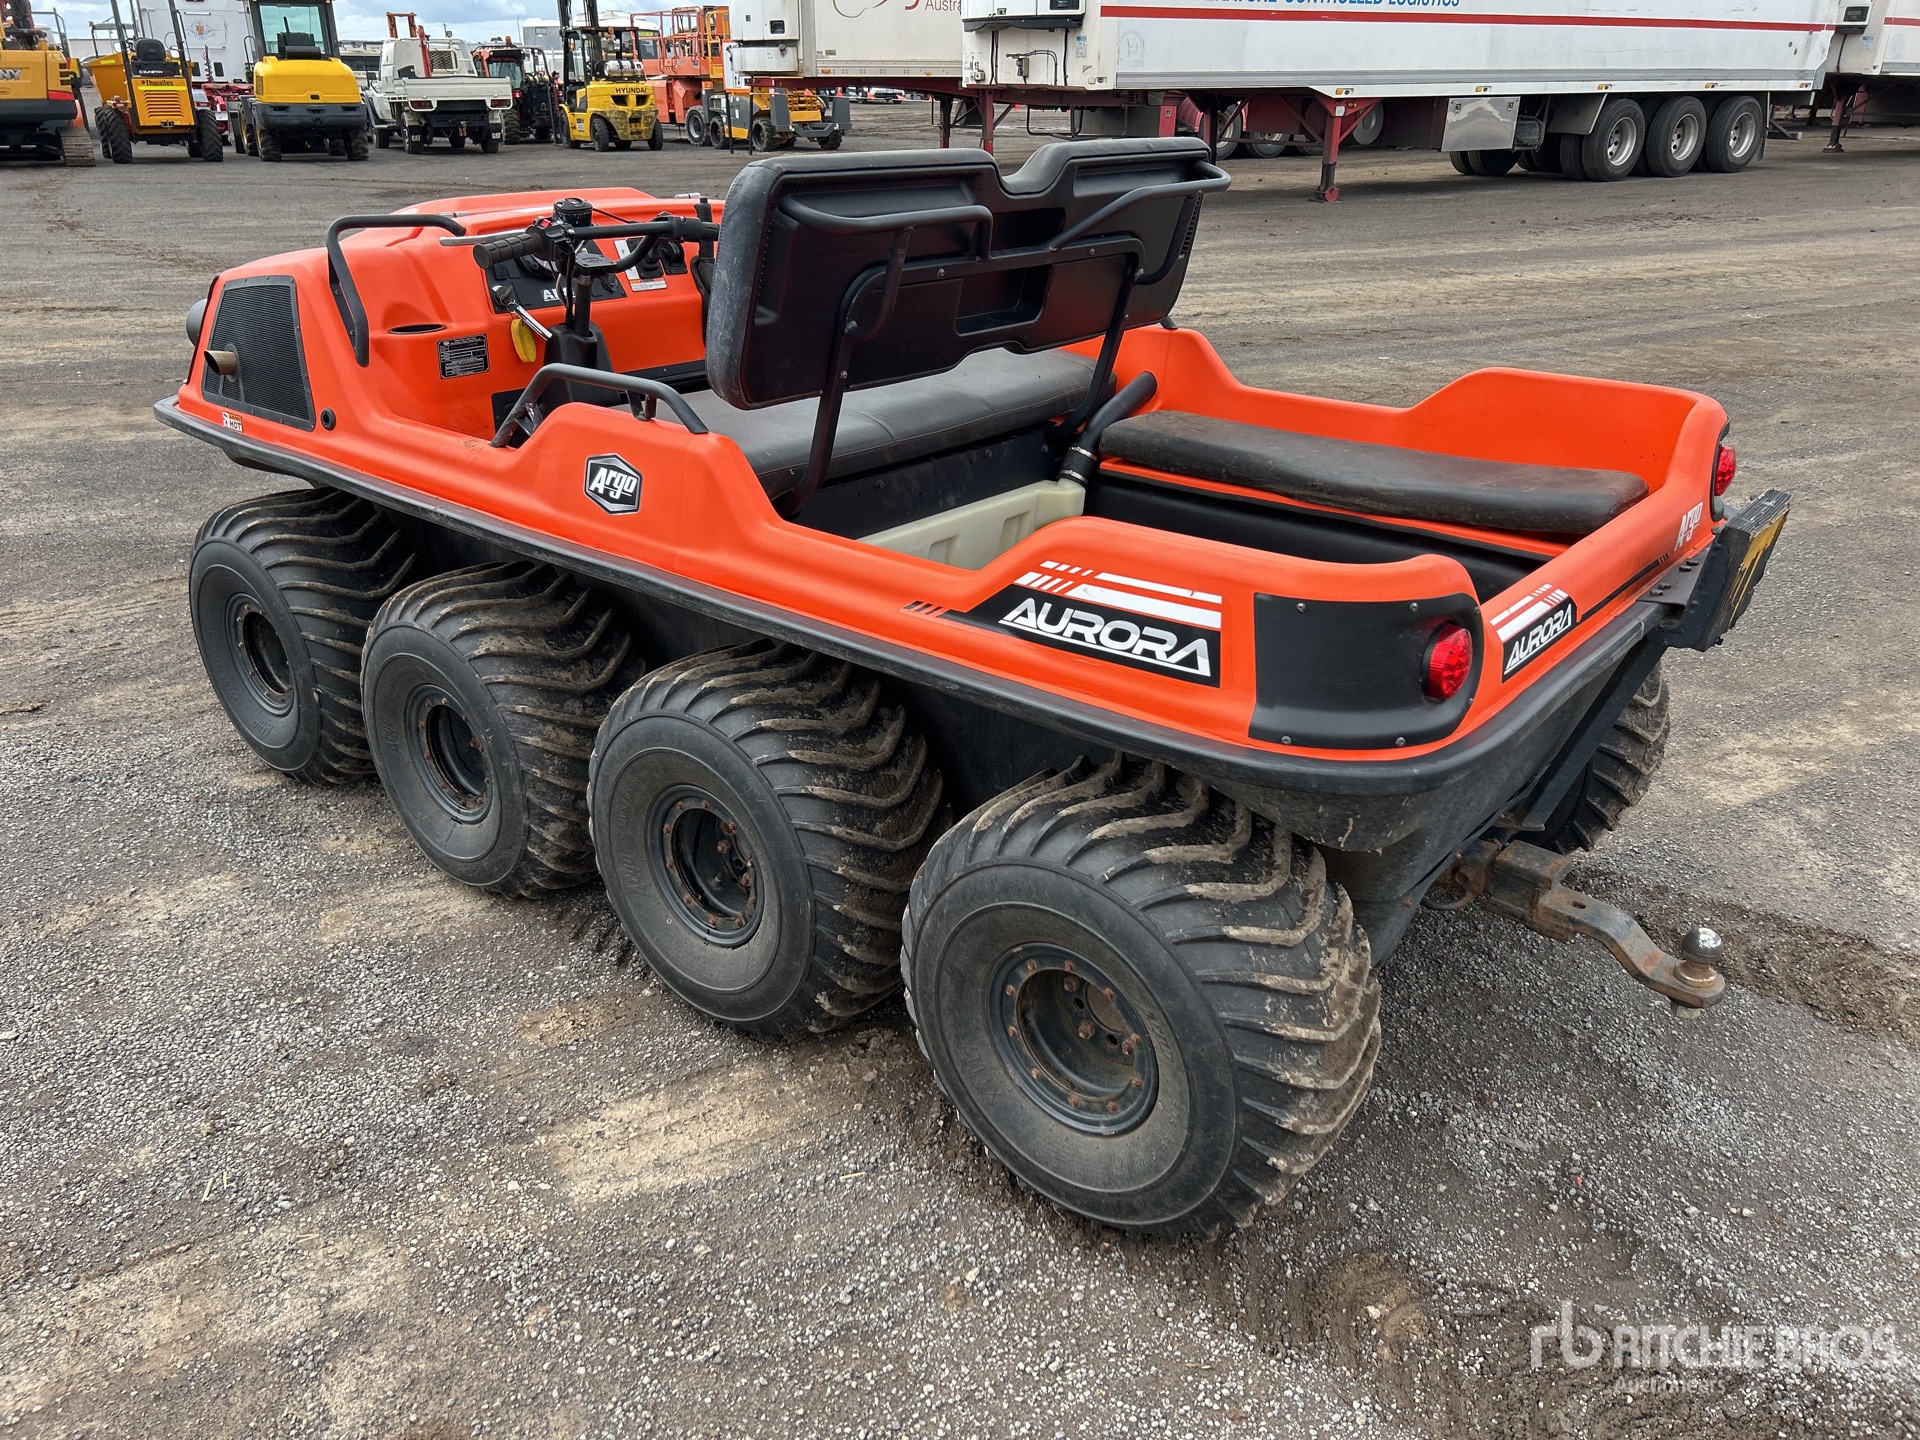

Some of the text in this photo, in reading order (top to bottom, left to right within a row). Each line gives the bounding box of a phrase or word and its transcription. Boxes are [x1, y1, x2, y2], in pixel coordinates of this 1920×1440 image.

[229, 420, 242, 430] HOT
[589, 466, 638, 500] Argo
[1673, 501, 1703, 552] Argo
[999, 597, 1212, 677] AURORA
[1504, 603, 1572, 675] AURORA
